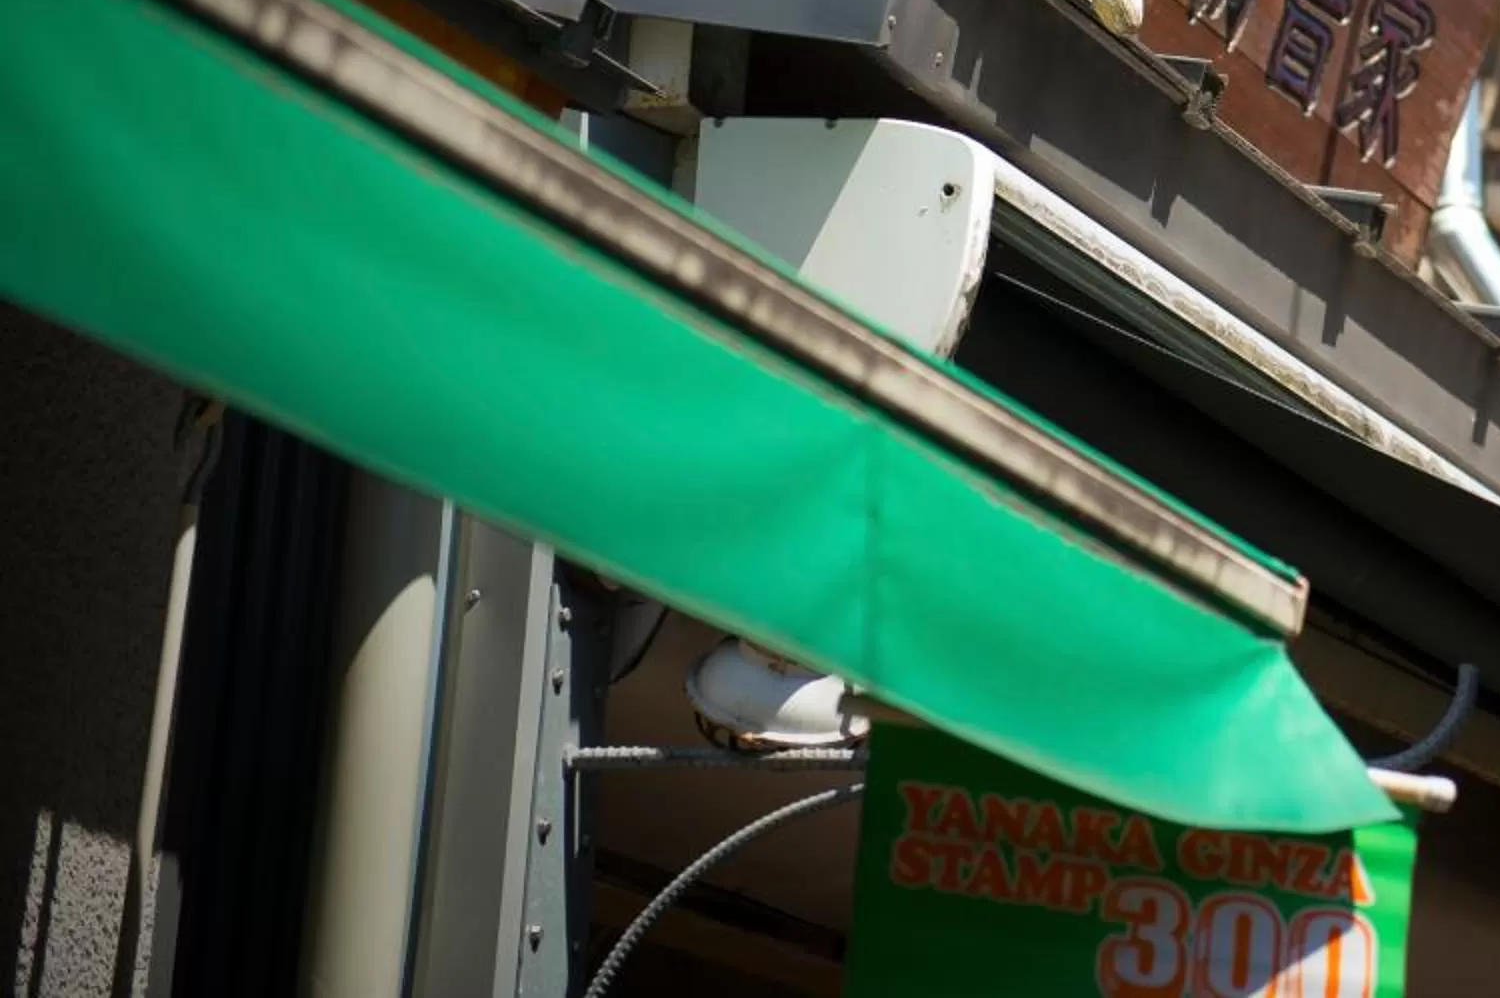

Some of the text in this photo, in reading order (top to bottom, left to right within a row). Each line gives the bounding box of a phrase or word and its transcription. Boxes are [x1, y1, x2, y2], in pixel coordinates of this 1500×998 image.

[890, 835, 1108, 913] STAMP
[899, 783, 1376, 905] YANAKA GINZA
[1096, 876, 1378, 998] 300
